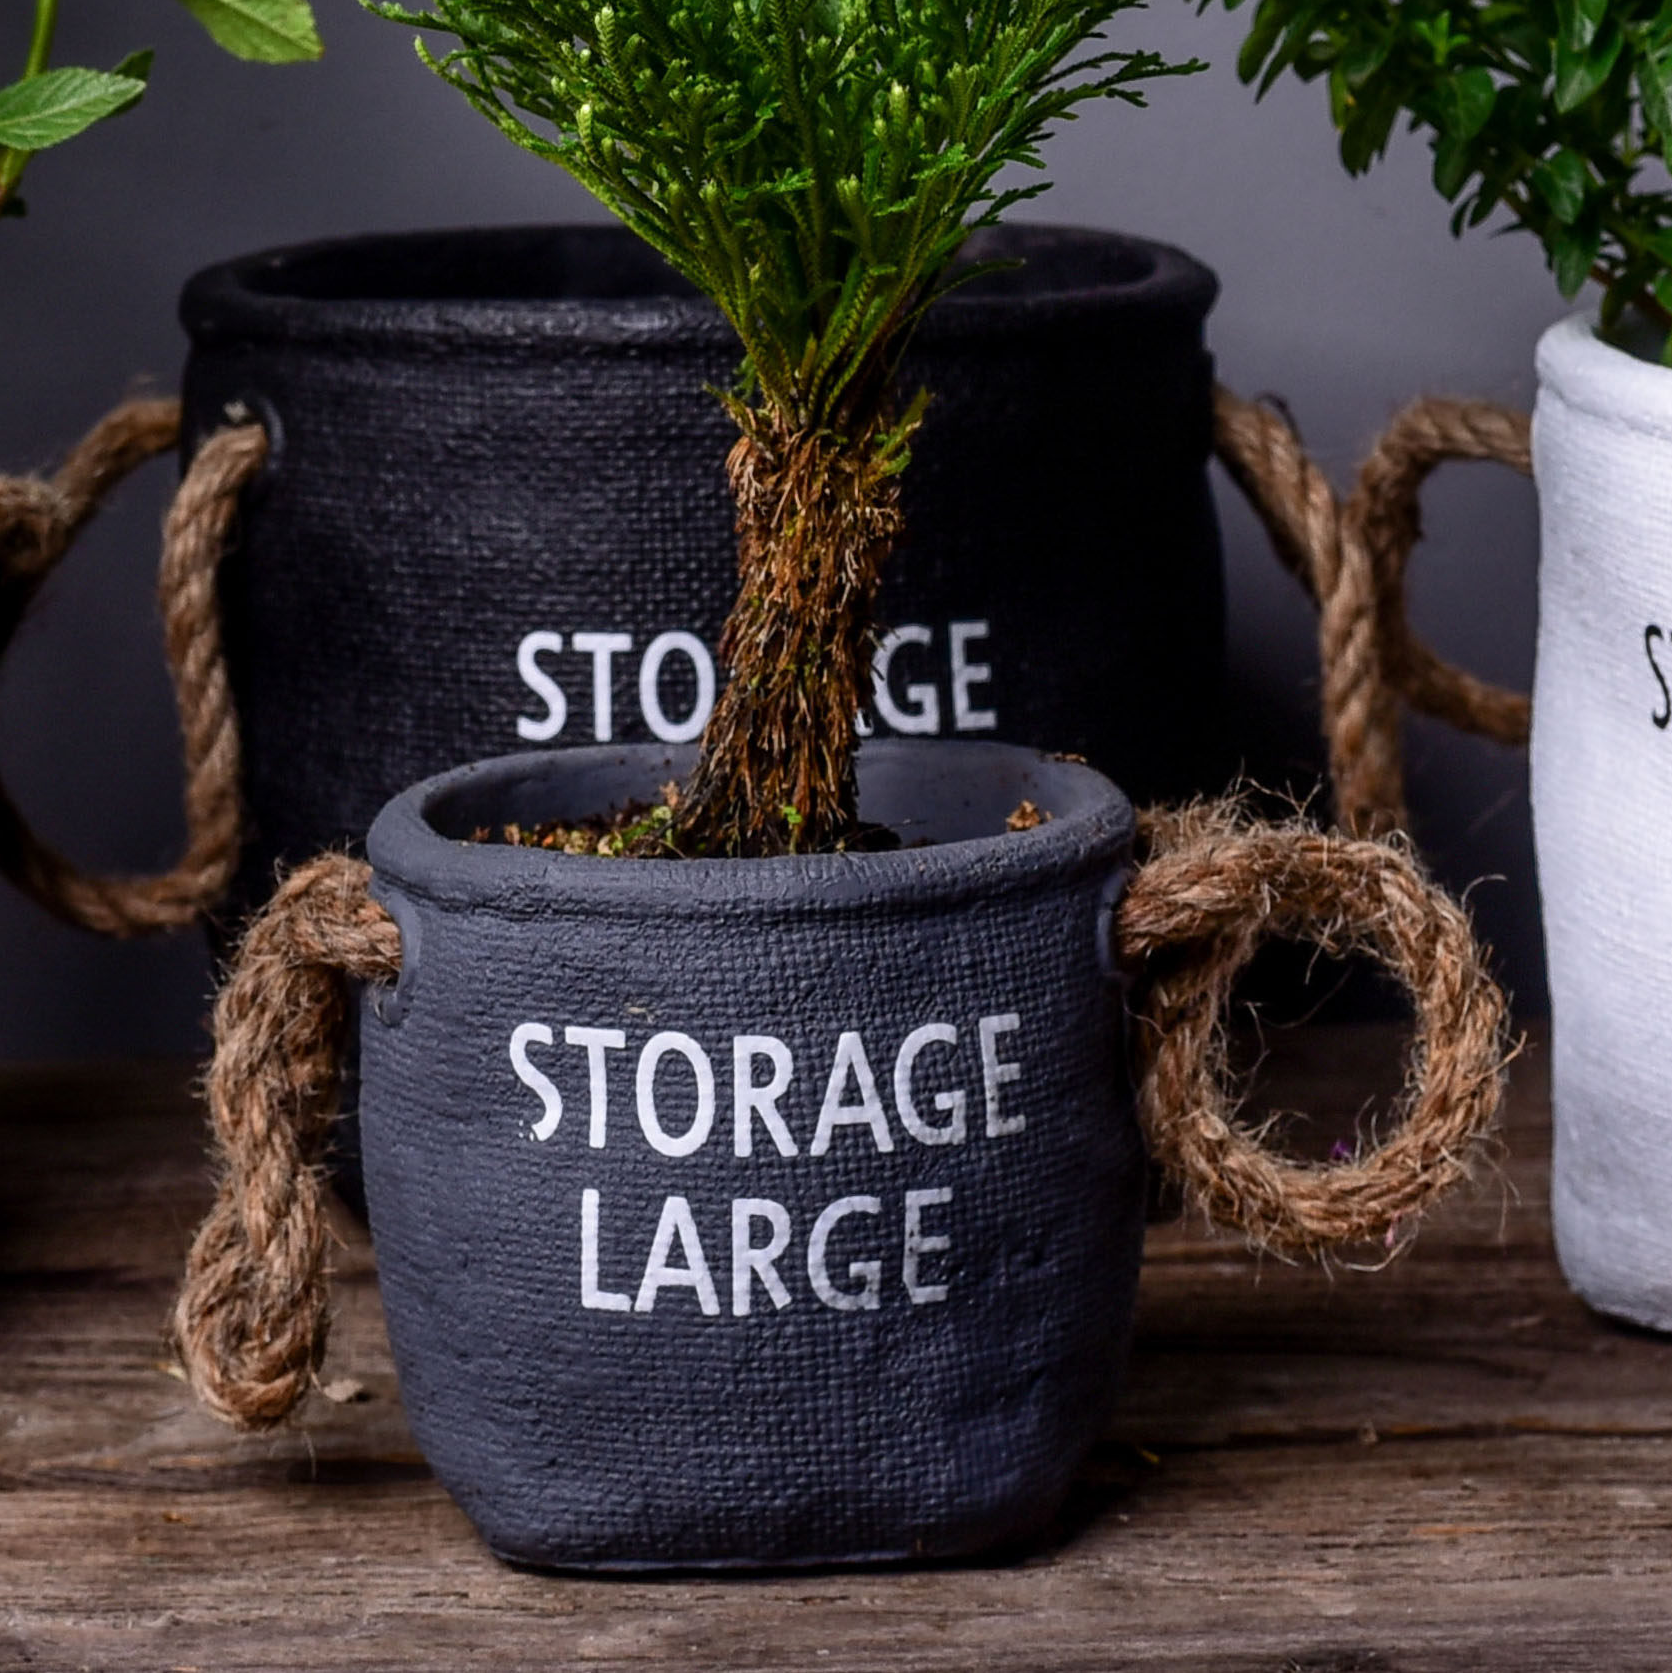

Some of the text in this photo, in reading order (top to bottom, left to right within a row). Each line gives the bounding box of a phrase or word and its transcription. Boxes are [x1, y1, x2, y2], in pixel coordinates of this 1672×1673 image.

[516, 620, 998, 743] STOGE
[509, 1013, 1027, 1158] STORAGE
[580, 1187, 953, 1316] LARGE
